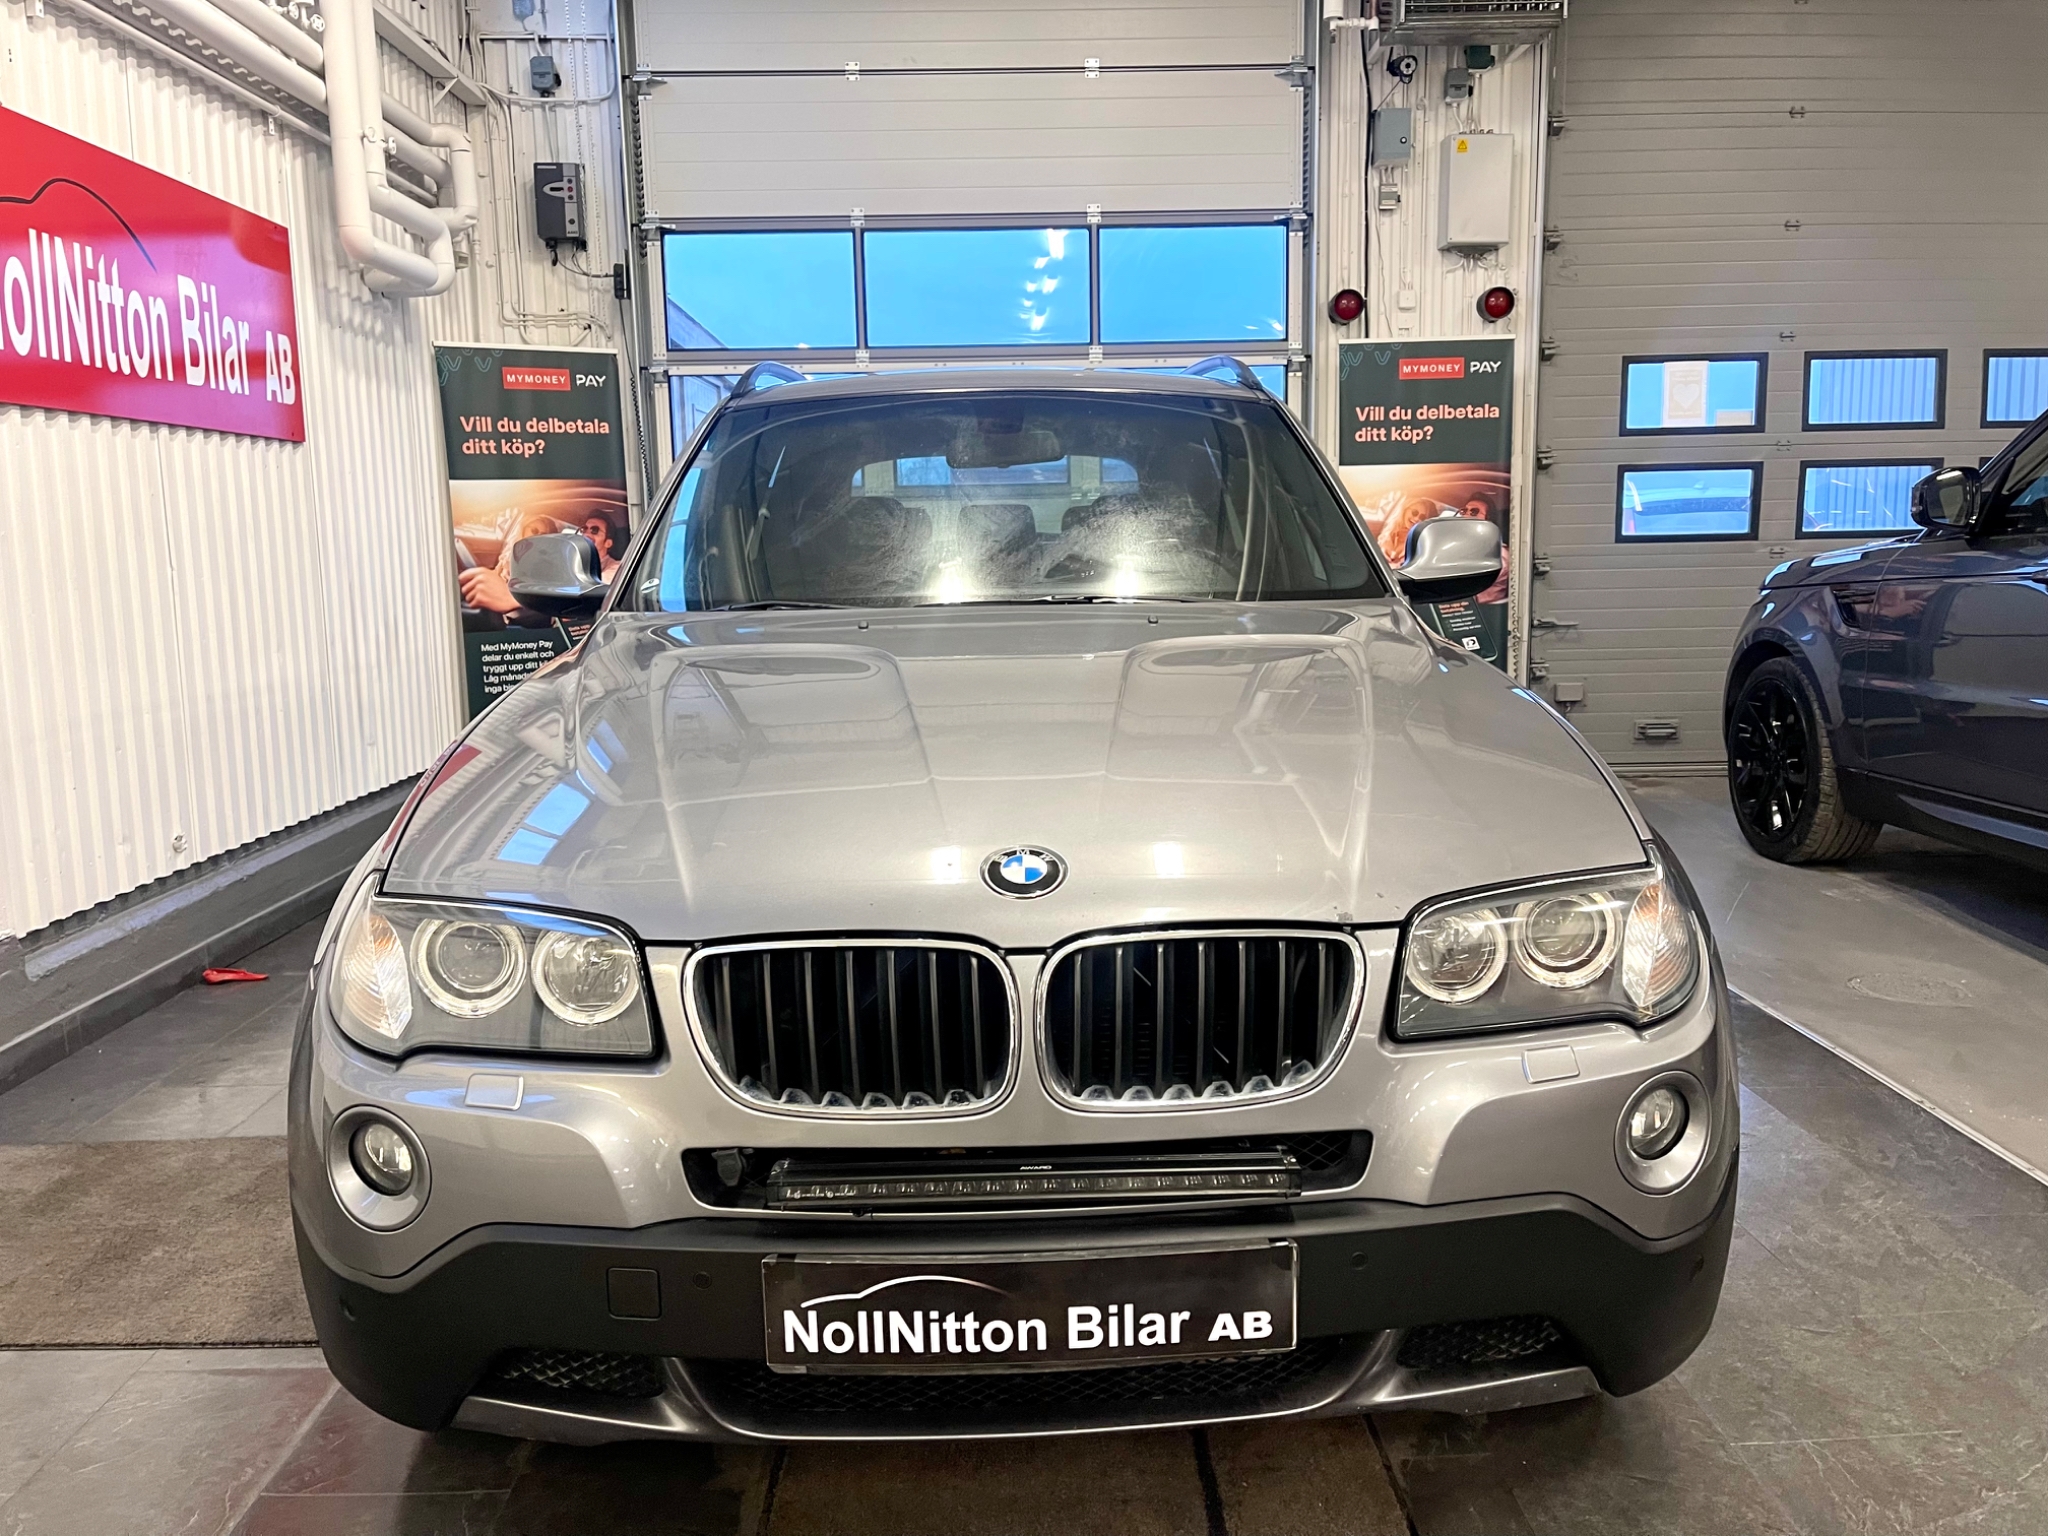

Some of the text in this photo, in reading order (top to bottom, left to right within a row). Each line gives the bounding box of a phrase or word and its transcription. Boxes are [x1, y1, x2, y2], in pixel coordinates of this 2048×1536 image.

[0, 228, 296, 405] ollNitton Bilar AB
[1403, 361, 1501, 373] MYMONEY PAY
[506, 374, 606, 387] MYMONEY PAY
[1355, 404, 1500, 421] Vill du delbetala
[460, 416, 610, 434] Vill du delbetala
[1355, 425, 1434, 444] ditt köp?
[462, 439, 546, 458] ditt köp?
[481, 640, 554, 651] Med MyMoney Pay
[482, 654, 502, 662] delar
[515, 651, 539, 660] enkelt
[540, 650, 555, 658] och
[483, 664, 507, 674] tryggt
[508, 664, 524, 672] upp
[525, 661, 538, 669] ditt
[483, 674, 499, 684] Låg
[484, 685, 502, 694] inga
[783, 1303, 1273, 1354] NollNitton Bilar AB
